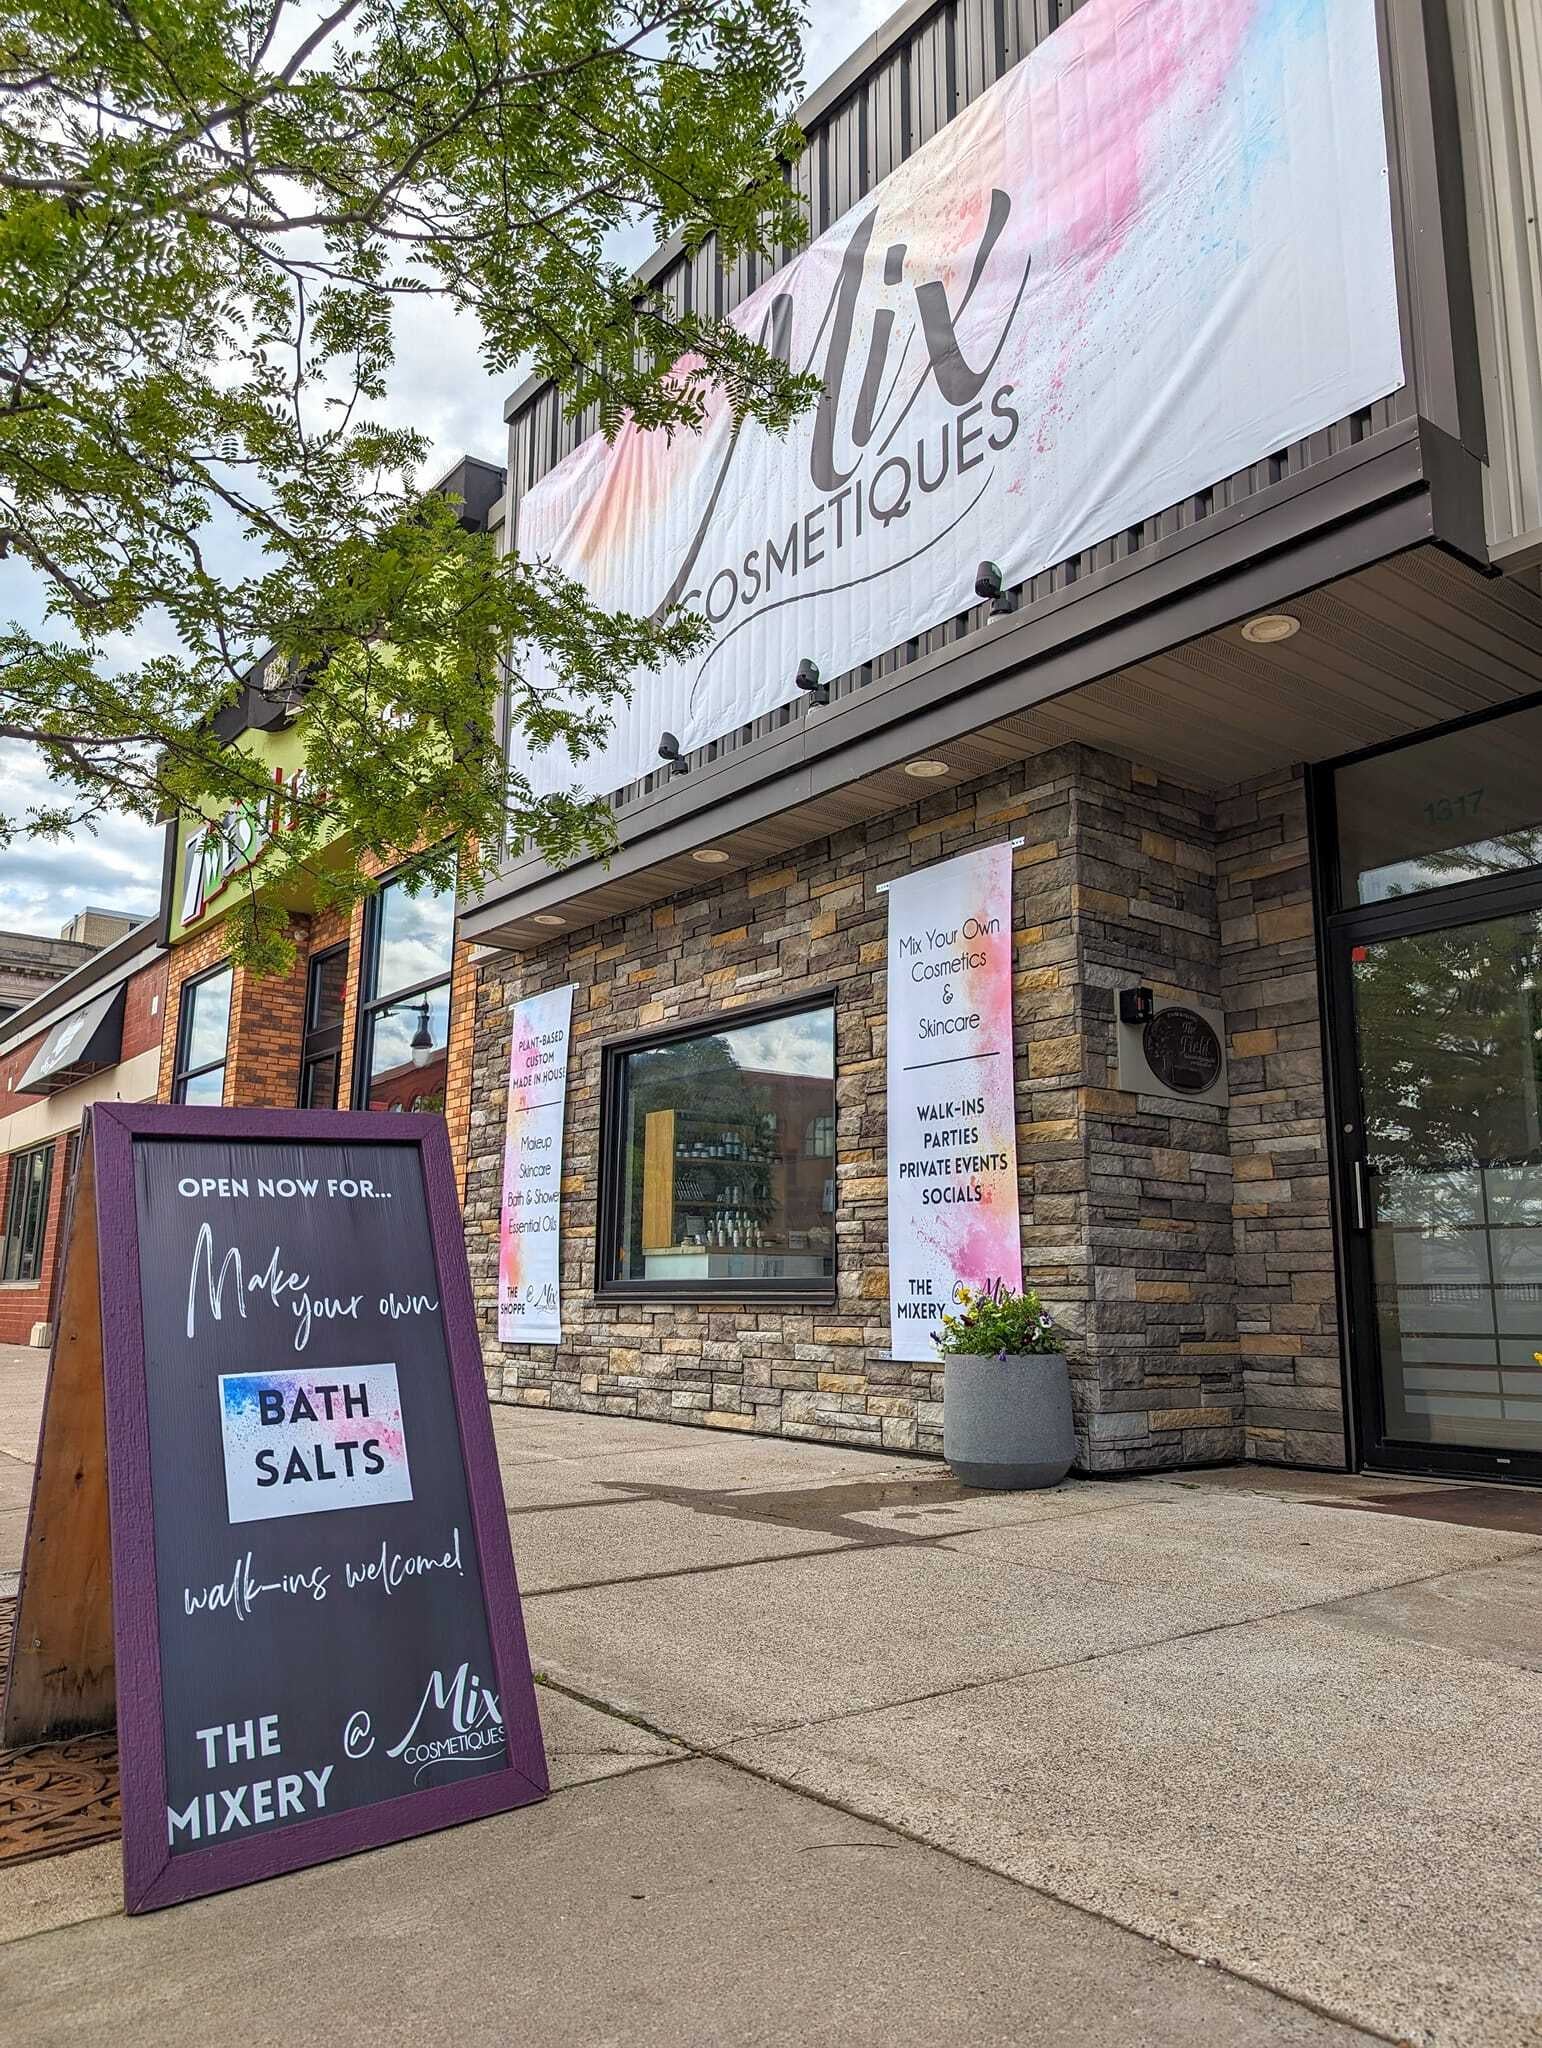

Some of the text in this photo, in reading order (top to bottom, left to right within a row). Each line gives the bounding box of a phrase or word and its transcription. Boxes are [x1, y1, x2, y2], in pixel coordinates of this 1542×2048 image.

[655, 188, 1032, 626] Mix
[899, 917, 1000, 958] Mix Your Own
[911, 951, 987, 982] Cosmetics
[942, 983, 954, 1005] &
[918, 1012, 981, 1039] Skincare
[518, 1030, 564, 1052] PLANT-BASED
[525, 1052, 555, 1068] CUSTOM
[512, 1075, 532, 1089] MADE
[533, 1073, 541, 1086] IN
[917, 1097, 985, 1121] WALK-INS
[520, 1135, 553, 1152] Makeup
[924, 1127, 979, 1149] PARTIES
[519, 1162, 552, 1179] Skincare
[899, 1153, 1008, 1179] PRIVATE EVENTS
[177, 1177, 393, 1200] OPEN NOW FOR...
[507, 1191, 524, 1207] Bath
[526, 1189, 532, 1206] &
[922, 1185, 982, 1205] SOCIALS
[508, 1215, 557, 1234] Essential Oils
[187, 1222, 311, 1338] Make
[507, 1286, 518, 1298] THE
[908, 1279, 933, 1296] THE
[500, 1303, 526, 1315] SHOPPE
[897, 1302, 946, 1320] MIXERY
[292, 1292, 440, 1351] your own
[258, 1382, 371, 1427] BATH
[254, 1439, 386, 1488] SALTS
[184, 1527, 466, 1621] walk-ins welcome!
[385, 1661, 504, 1759] Mix
[196, 1714, 282, 1769] THE
[343, 1710, 375, 1760] @
[403, 1725, 506, 1765] COSMETIQUES
[166, 1765, 335, 1846] MIXERY
